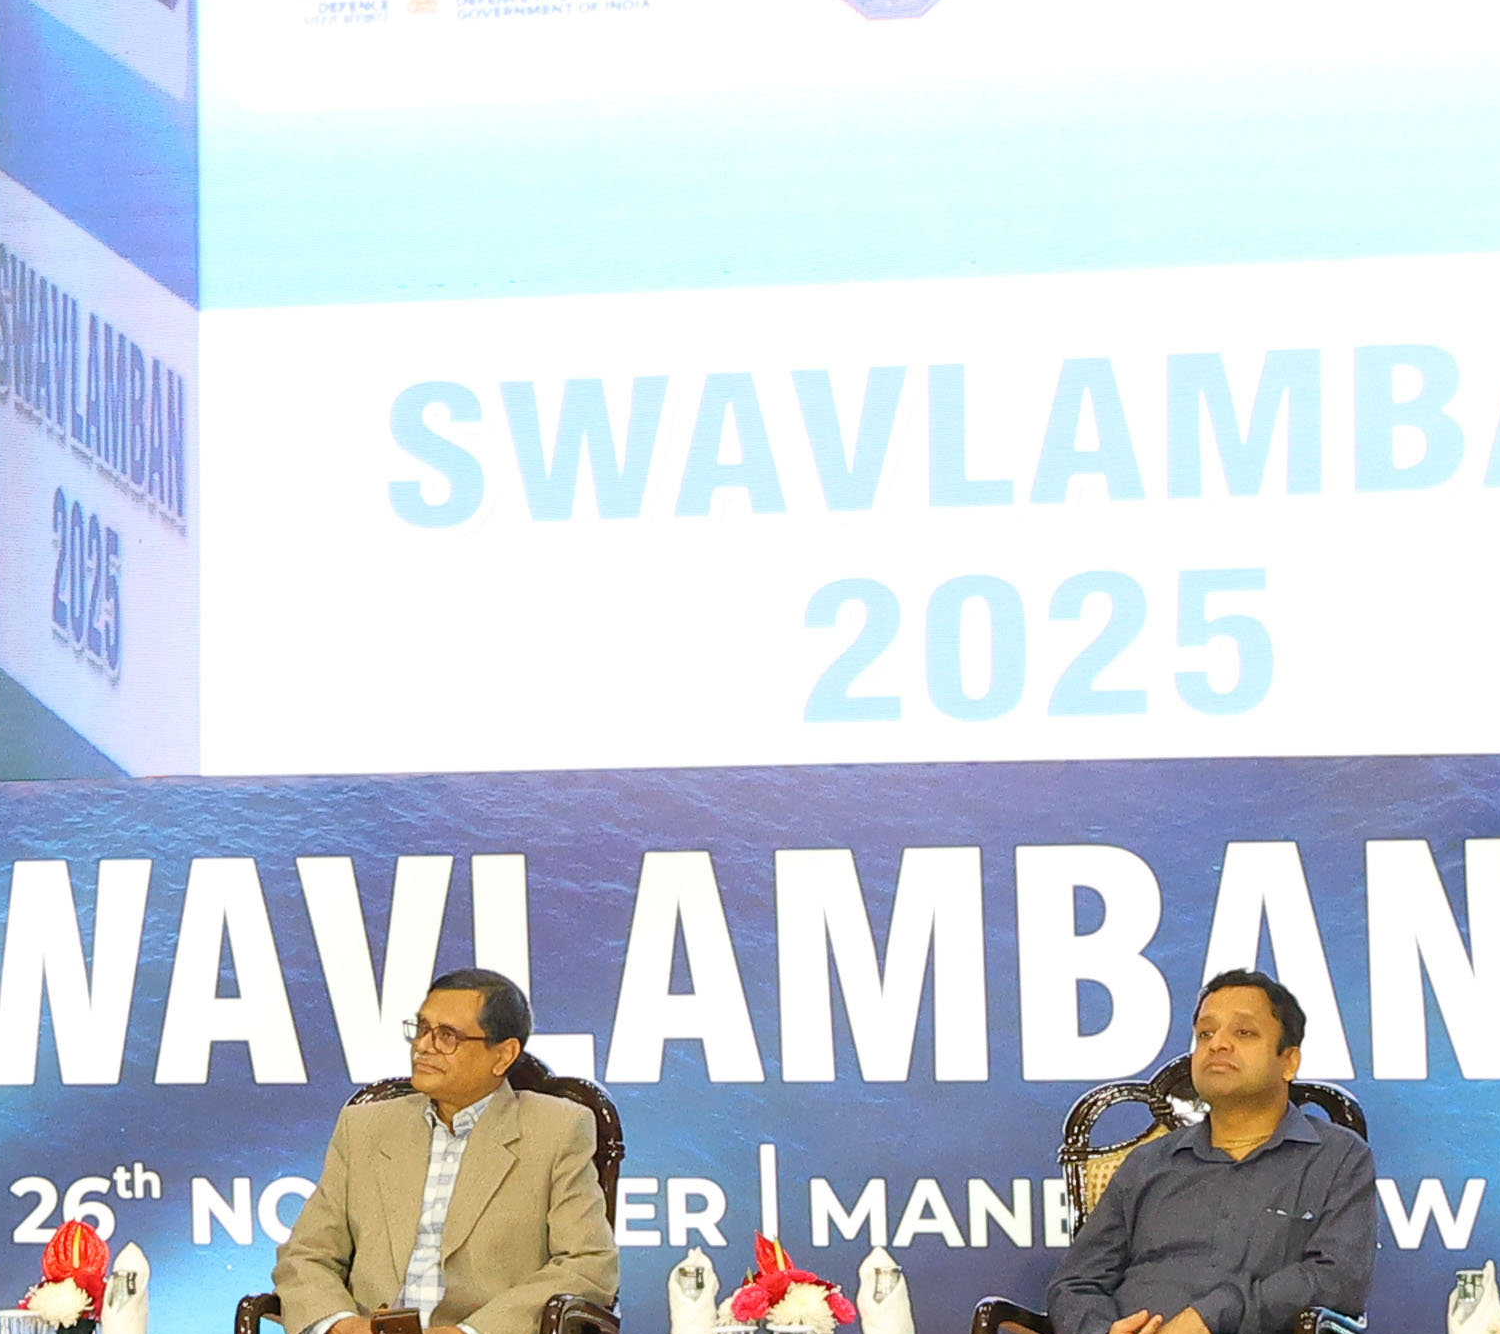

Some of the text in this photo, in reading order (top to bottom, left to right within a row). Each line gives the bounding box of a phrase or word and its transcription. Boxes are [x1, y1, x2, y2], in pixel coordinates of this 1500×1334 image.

[52, 485, 120, 671] 2025
[803, 567, 1274, 724] 2025
[9, 1162, 161, 1245] 26th
